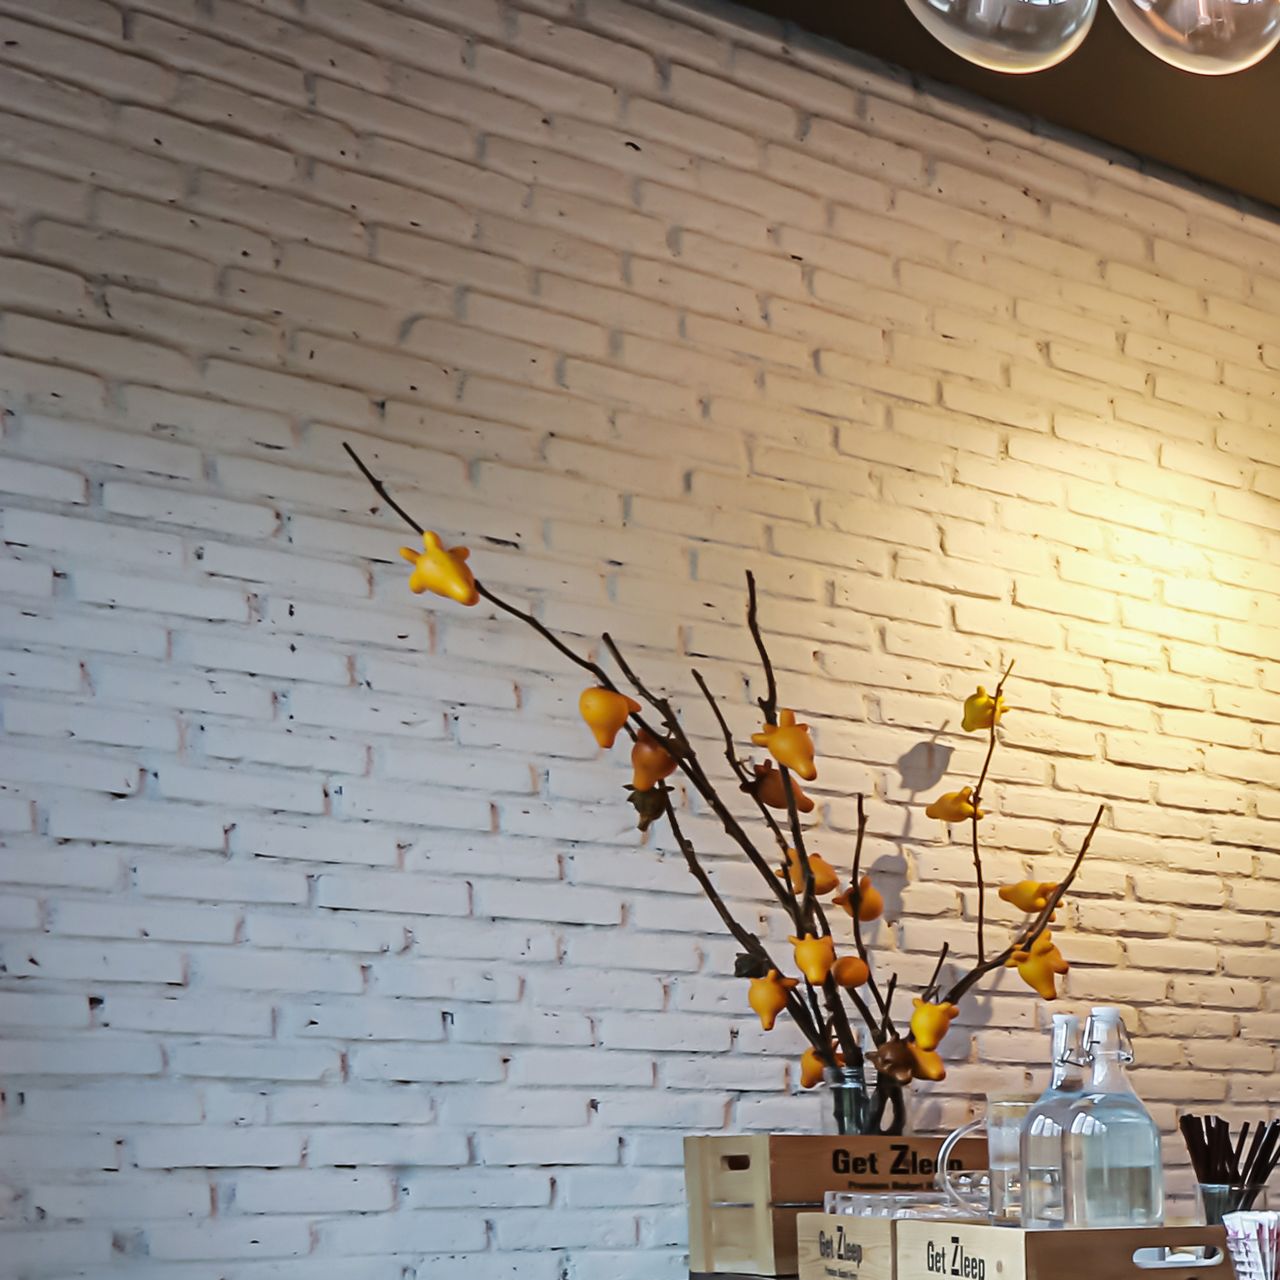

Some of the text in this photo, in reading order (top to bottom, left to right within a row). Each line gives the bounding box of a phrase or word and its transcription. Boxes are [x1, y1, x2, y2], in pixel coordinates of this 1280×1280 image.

[832, 1148, 879, 1175] Get
[819, 1225, 863, 1269] Get Zleep
[927, 1240, 947, 1275] Get
